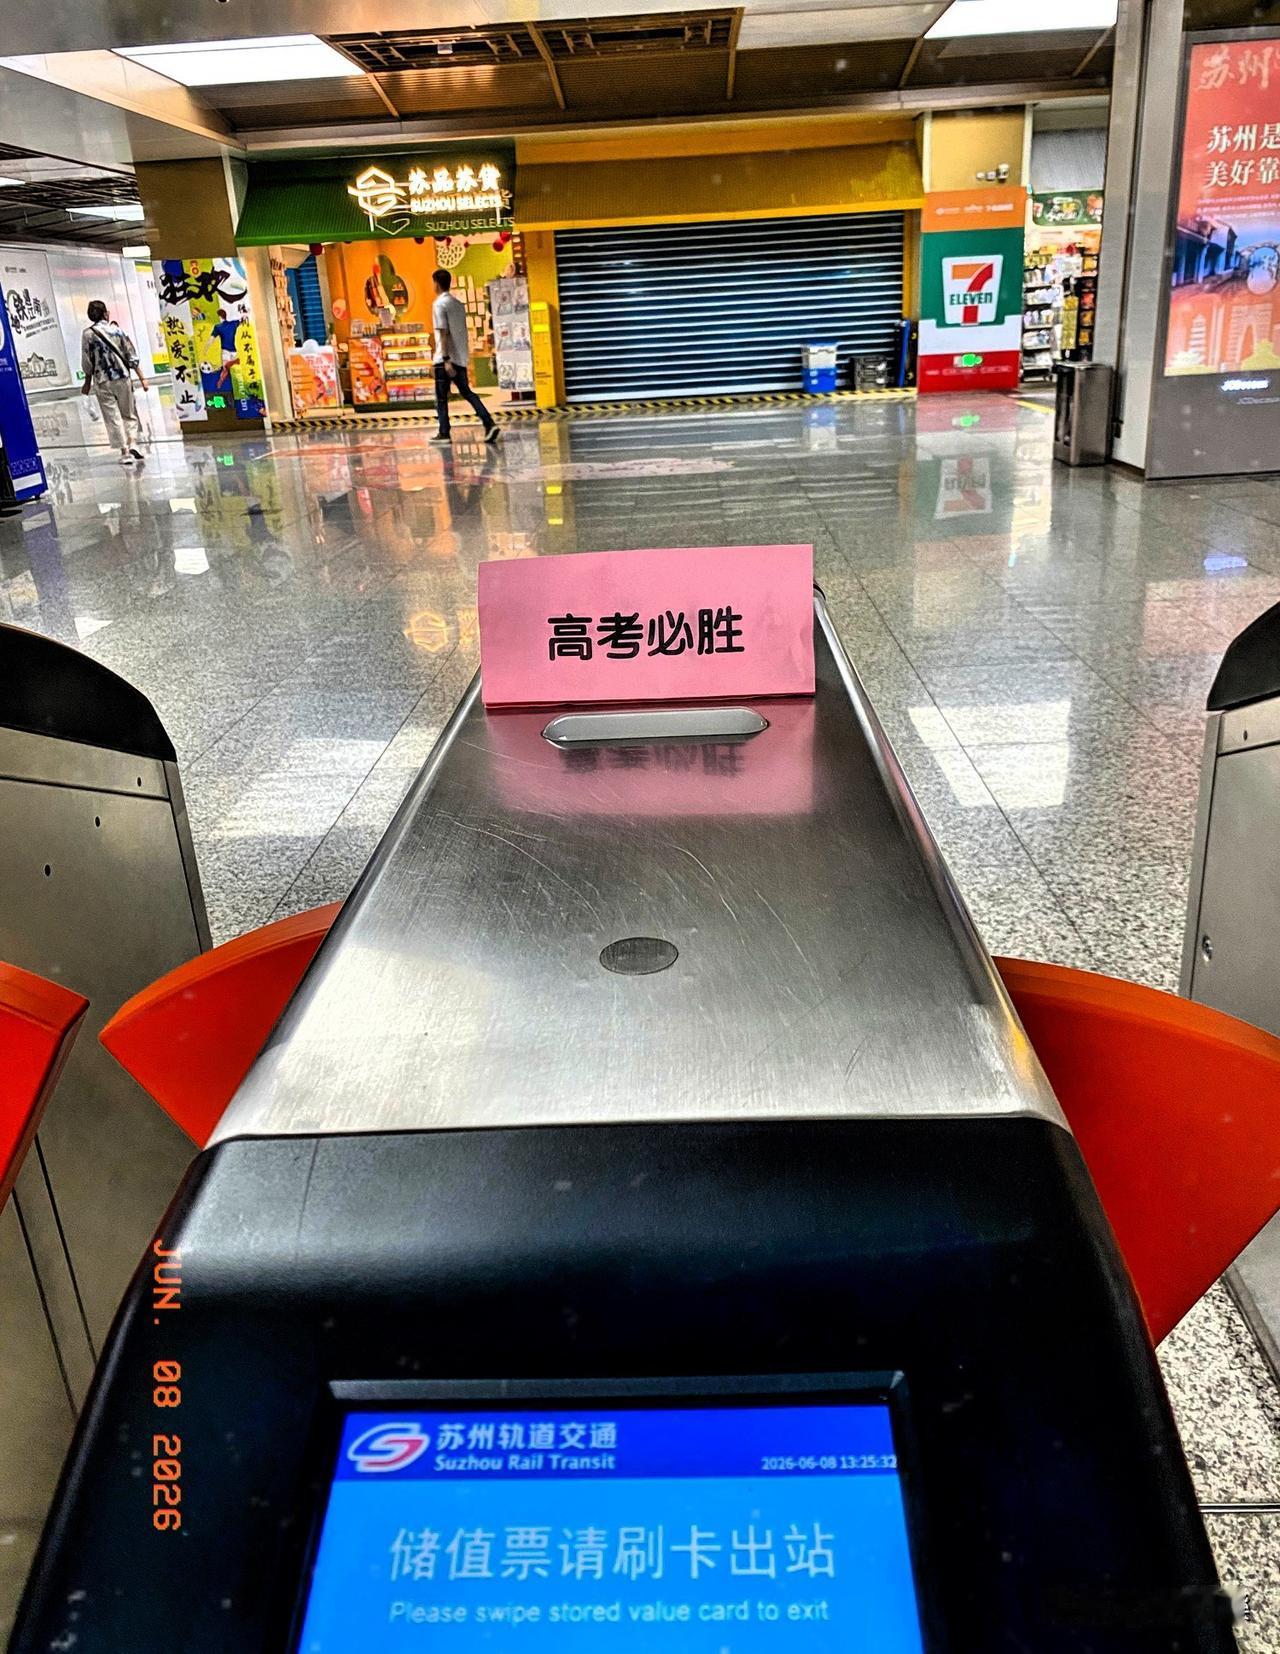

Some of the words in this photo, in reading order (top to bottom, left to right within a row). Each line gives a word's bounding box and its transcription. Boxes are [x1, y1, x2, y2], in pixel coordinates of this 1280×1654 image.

[1198, 46, 1280, 90] 苏州
[1207, 122, 1280, 154] 苏州是
[408, 162, 502, 196] 苏品苏货
[1203, 156, 1280, 189] 美好靠
[410, 195, 455, 213] SUZHOU
[456, 191, 503, 210] SELECTS
[425, 219, 469, 232] SUZHOU
[470, 216, 515, 230] SELECTS
[951, 263, 994, 324] 7
[165, 316, 197, 405] 热爱不止
[547, 605, 745, 661] 高考必胜
[437, 1422, 617, 1451] 苏州轨道交通
[434, 1453, 502, 1471] Suzhou
[508, 1453, 543, 1470] Rail
[548, 1453, 616, 1470] Transit
[761, 1456, 837, 1470] 2026-06-08
[390, 1522, 835, 1580] 储值票请刷卡出站
[389, 1602, 467, 1623] Please
[475, 1602, 540, 1627] swipe
[548, 1601, 620, 1623] stored
[629, 1601, 691, 1622] value
[699, 1600, 749, 1622] card
[757, 1600, 779, 1621] to
[787, 1600, 829, 1621] exit
